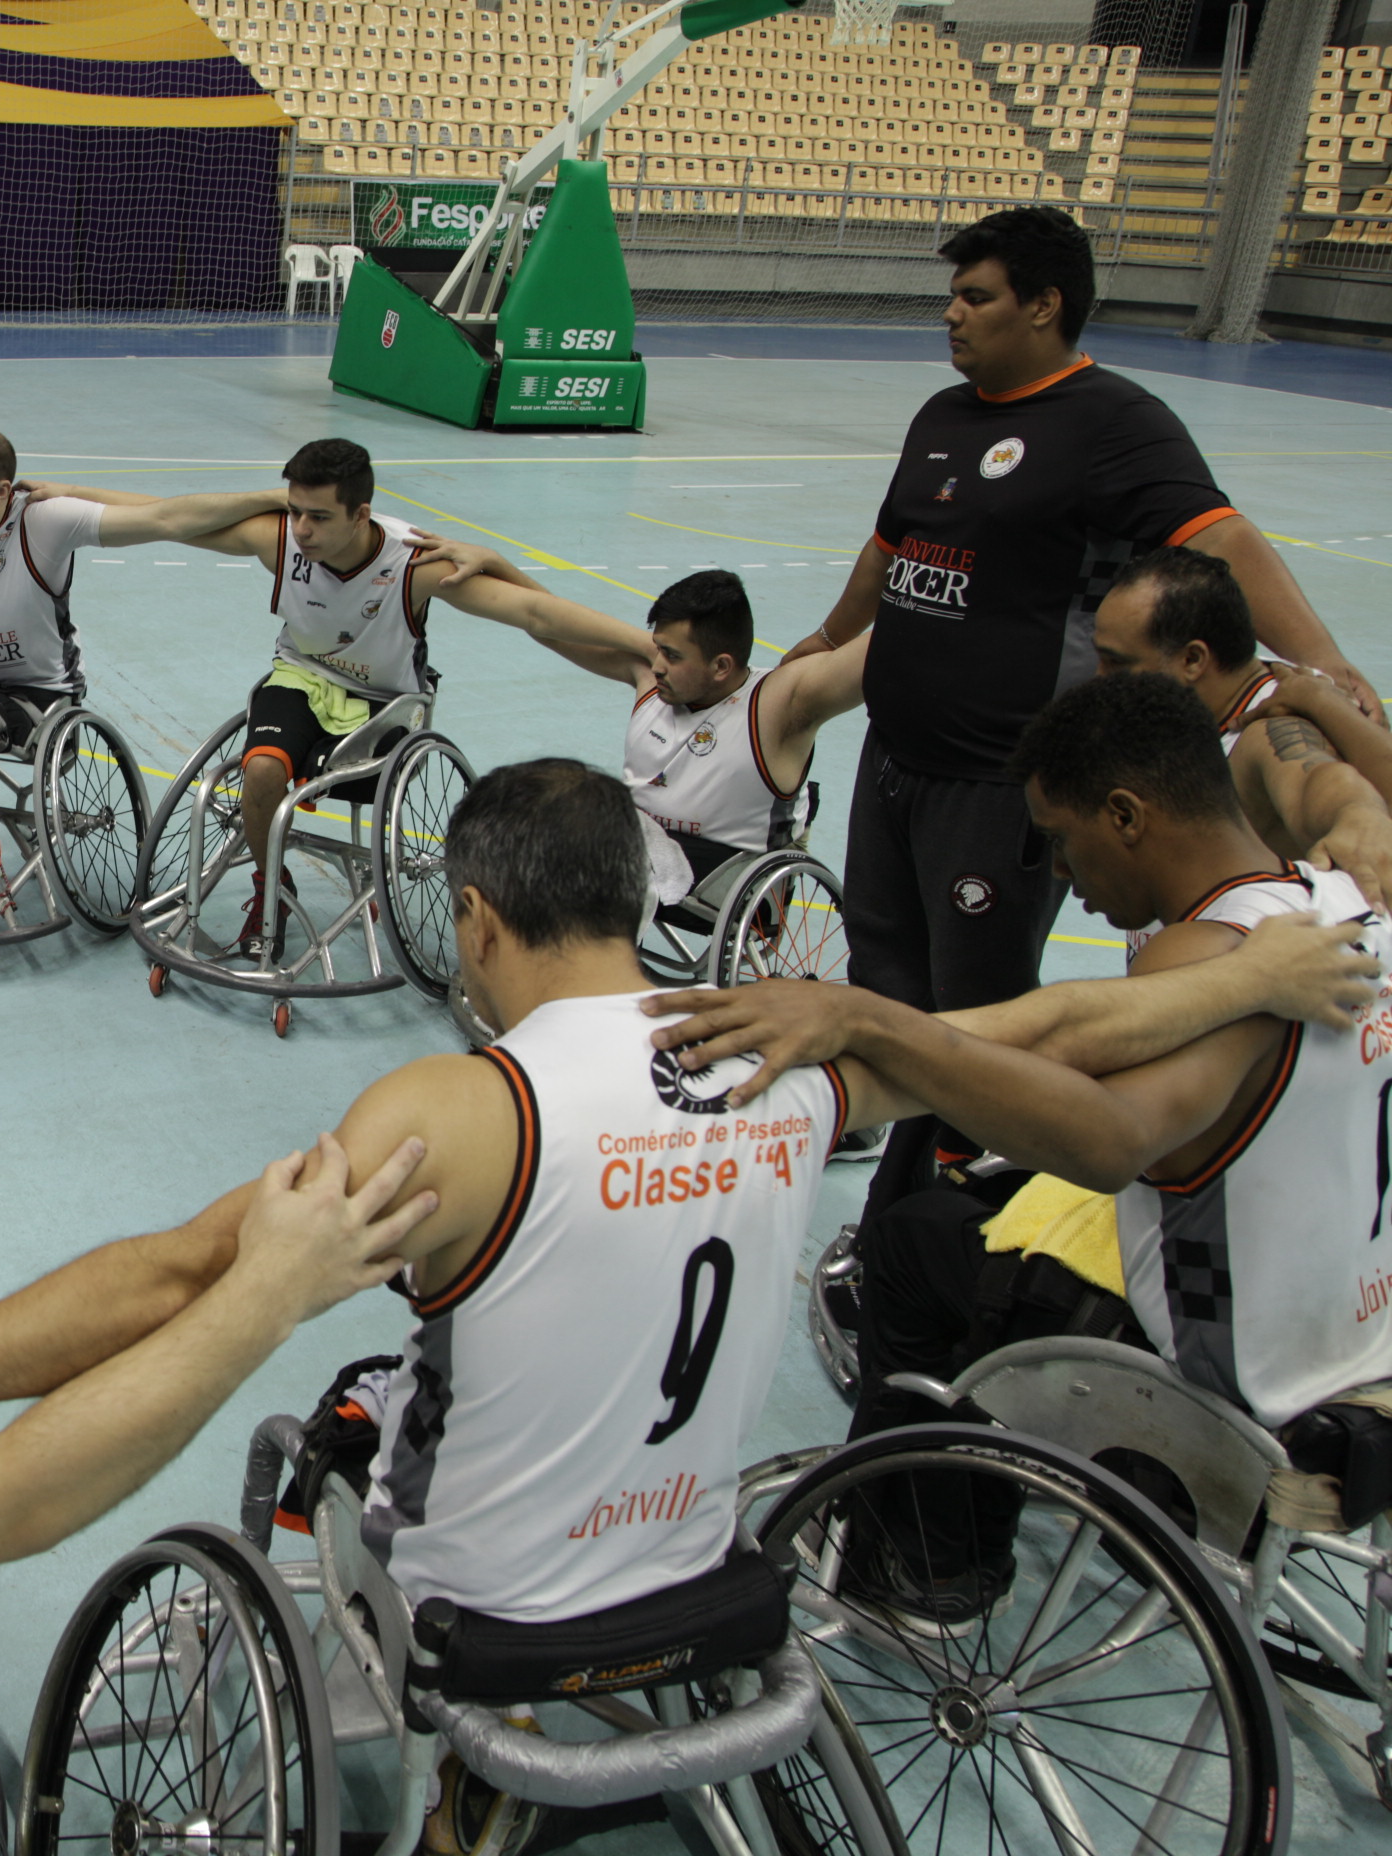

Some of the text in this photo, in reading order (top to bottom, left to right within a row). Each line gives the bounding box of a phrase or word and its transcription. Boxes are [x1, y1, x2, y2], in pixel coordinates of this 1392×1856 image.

[560, 329, 616, 350] SESI
[554, 377, 610, 398] SESI
[291, 552, 313, 585] 23
[897, 536, 976, 572] OINVILLE
[895, 595, 918, 611] Clube
[597, 1127, 697, 1155] Comércio
[704, 1121, 728, 1144] de
[600, 1157, 739, 1212] Classe
[644, 1235, 736, 1446] 9
